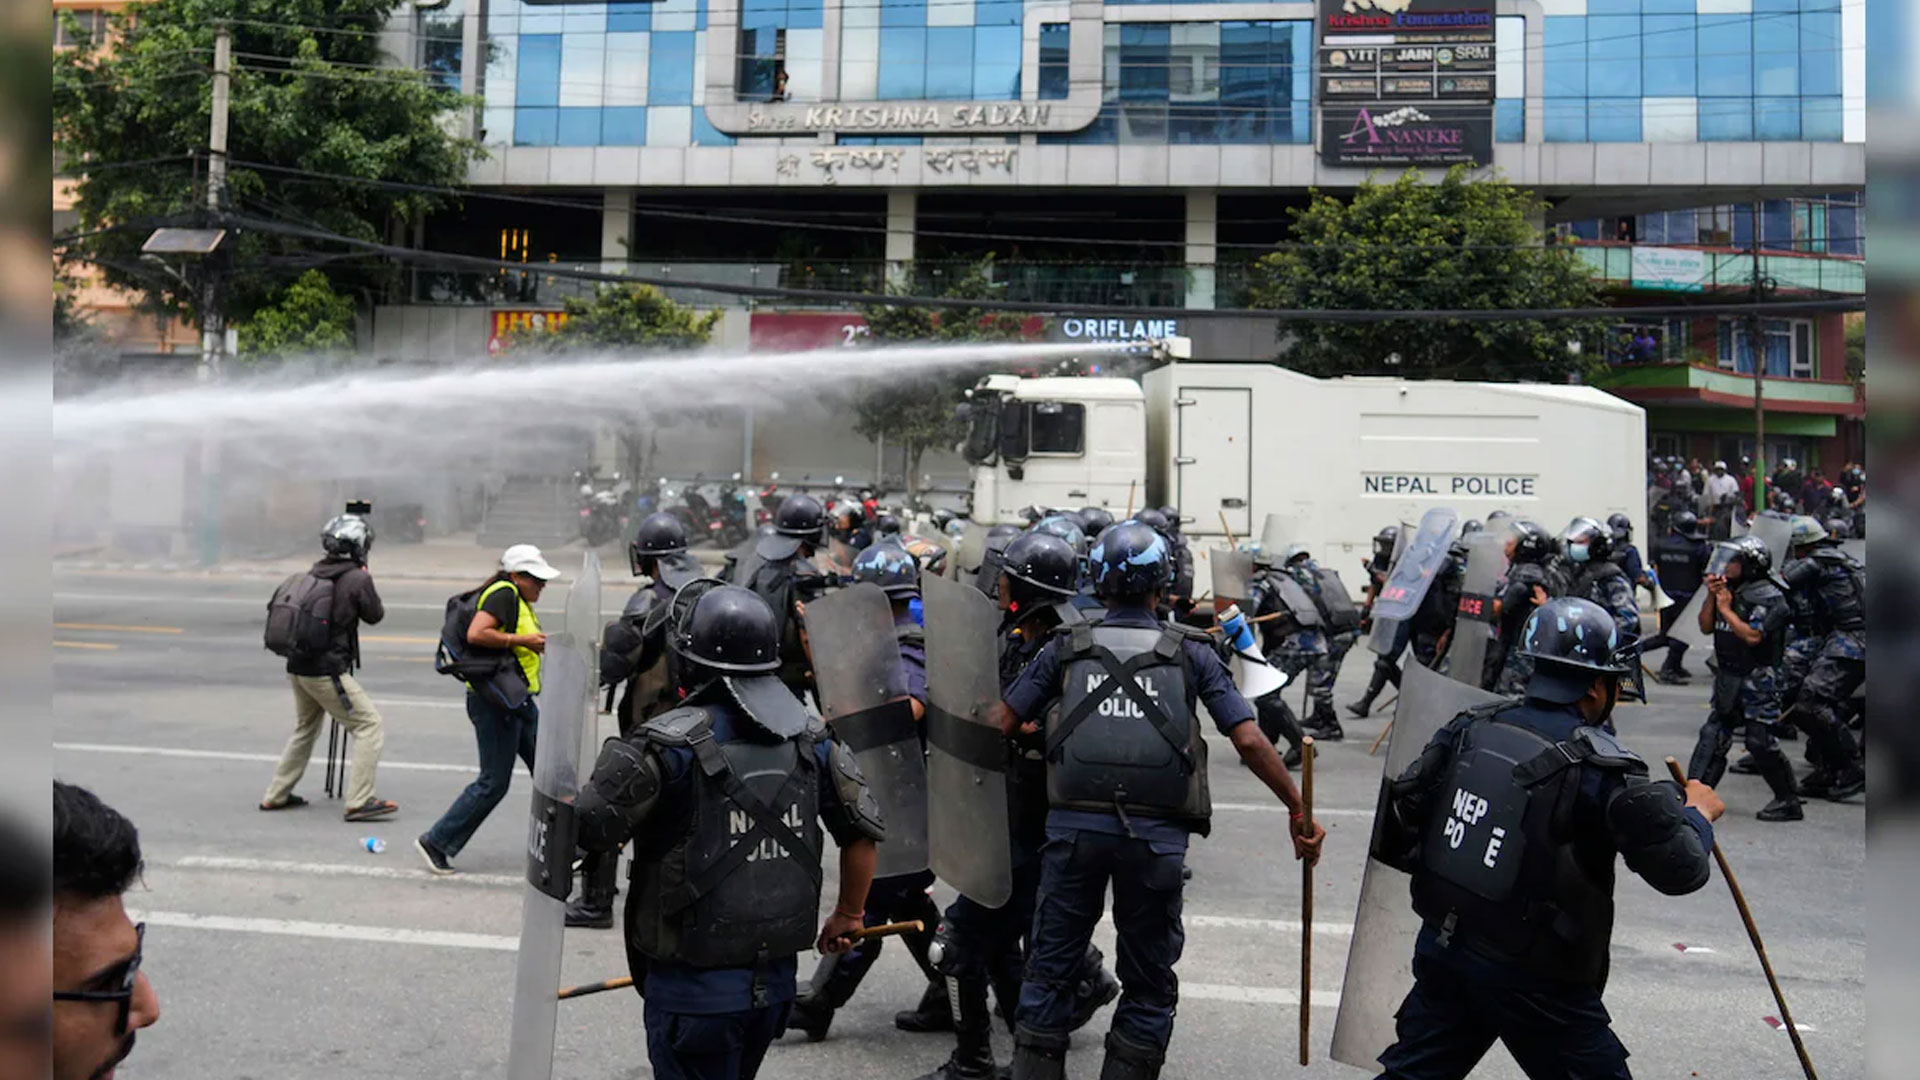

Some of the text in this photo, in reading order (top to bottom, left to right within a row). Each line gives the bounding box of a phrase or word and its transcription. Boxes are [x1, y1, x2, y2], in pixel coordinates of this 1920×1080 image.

[1329, 11, 1491, 27] Krishna Foundation
[1348, 50, 1375, 61] VIT
[1397, 49, 1432, 61] JAIN
[1455, 47, 1489, 59] SRM
[804, 105, 940, 129] KRISHNA
[951, 105, 1050, 128] SADAN
[1344, 107, 1463, 144] ANANEKE
[1063, 318, 1177, 338] ORIFLAME
[1365, 476, 1535, 495] NEPAL POLICE
